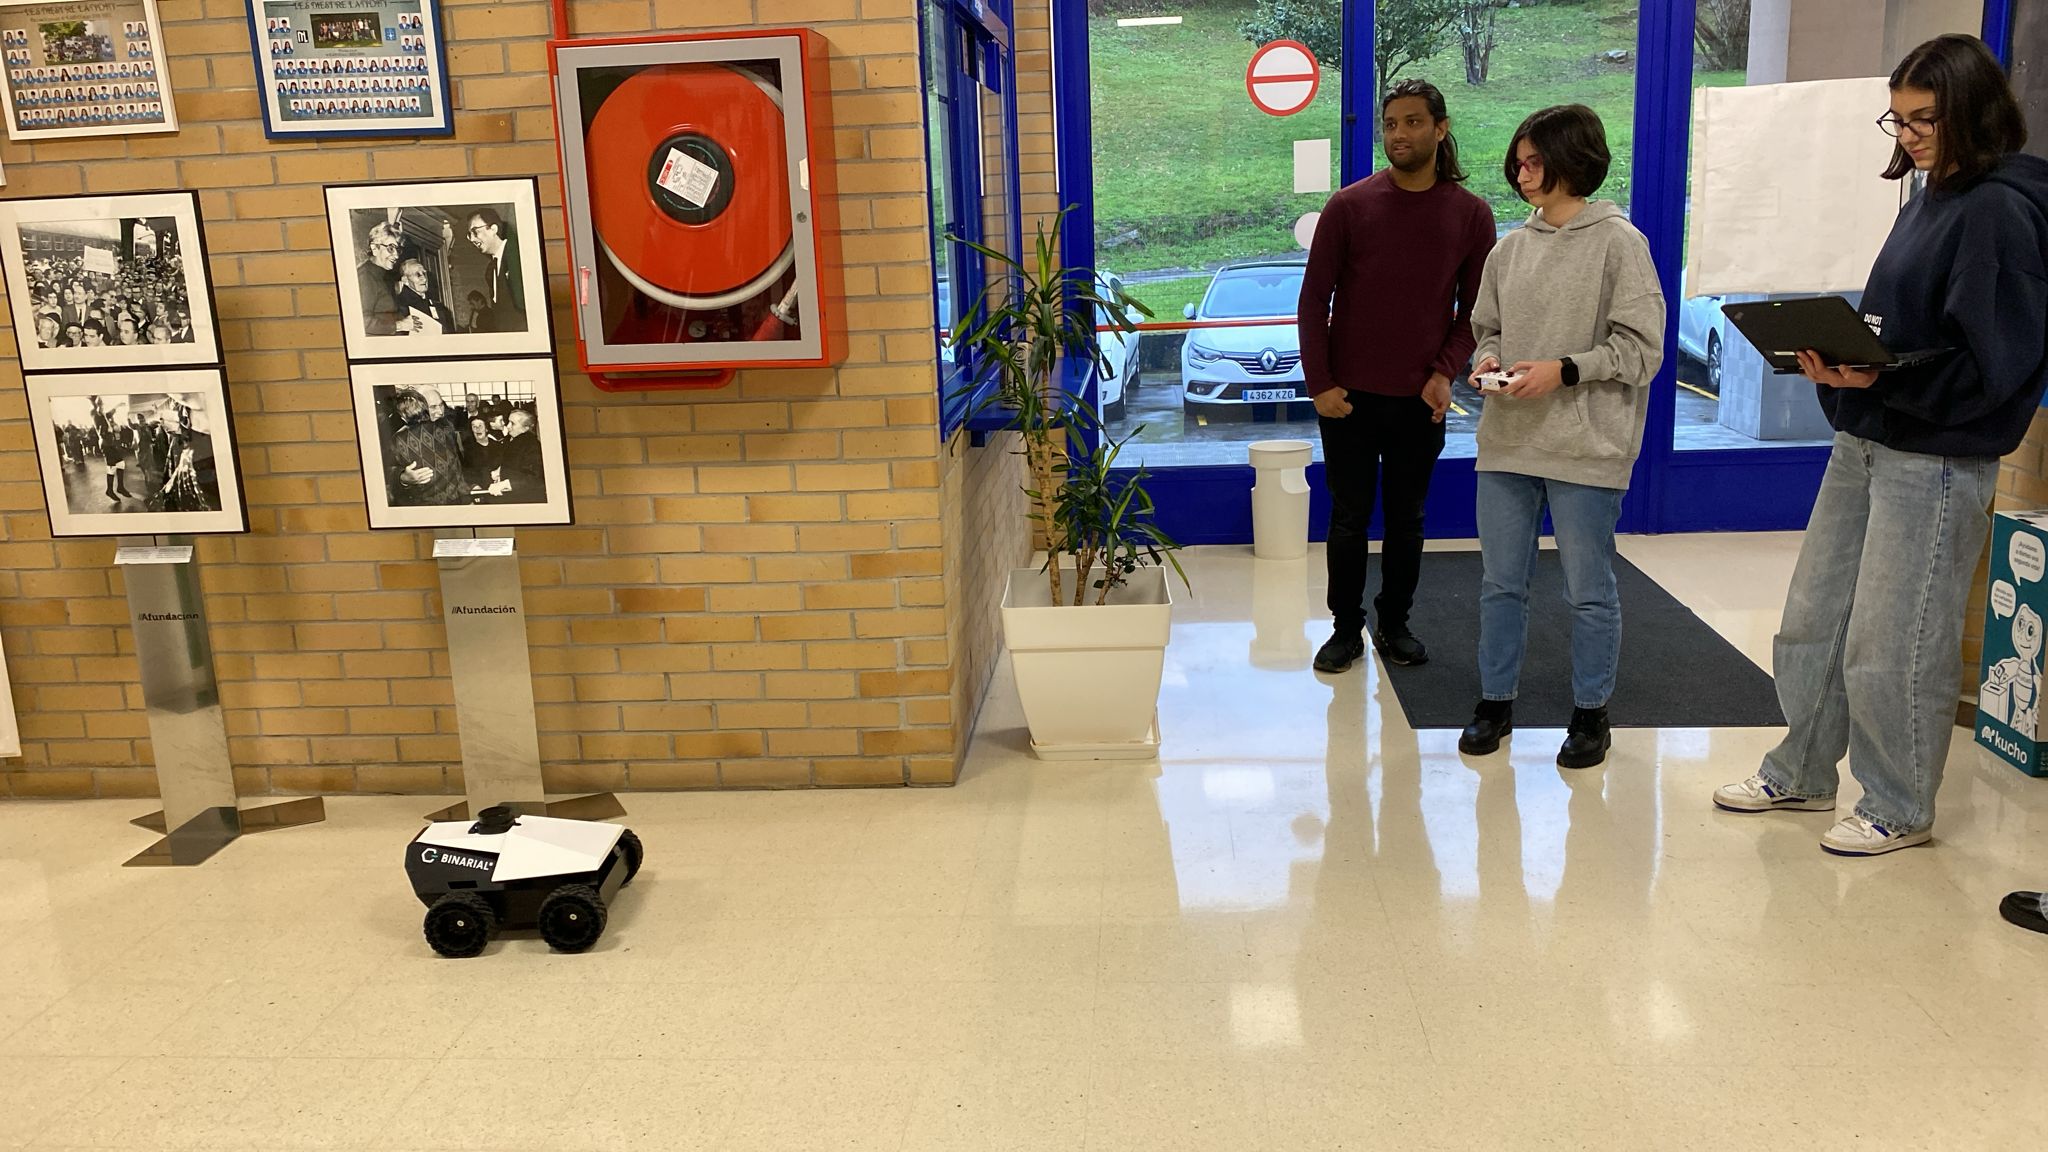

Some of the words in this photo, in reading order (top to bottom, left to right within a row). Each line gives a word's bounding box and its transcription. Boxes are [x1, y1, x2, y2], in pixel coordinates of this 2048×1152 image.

[1871, 315, 1882, 325] NOT
[1250, 391, 1273, 399] 4362
[1275, 390, 1293, 399] KZG
